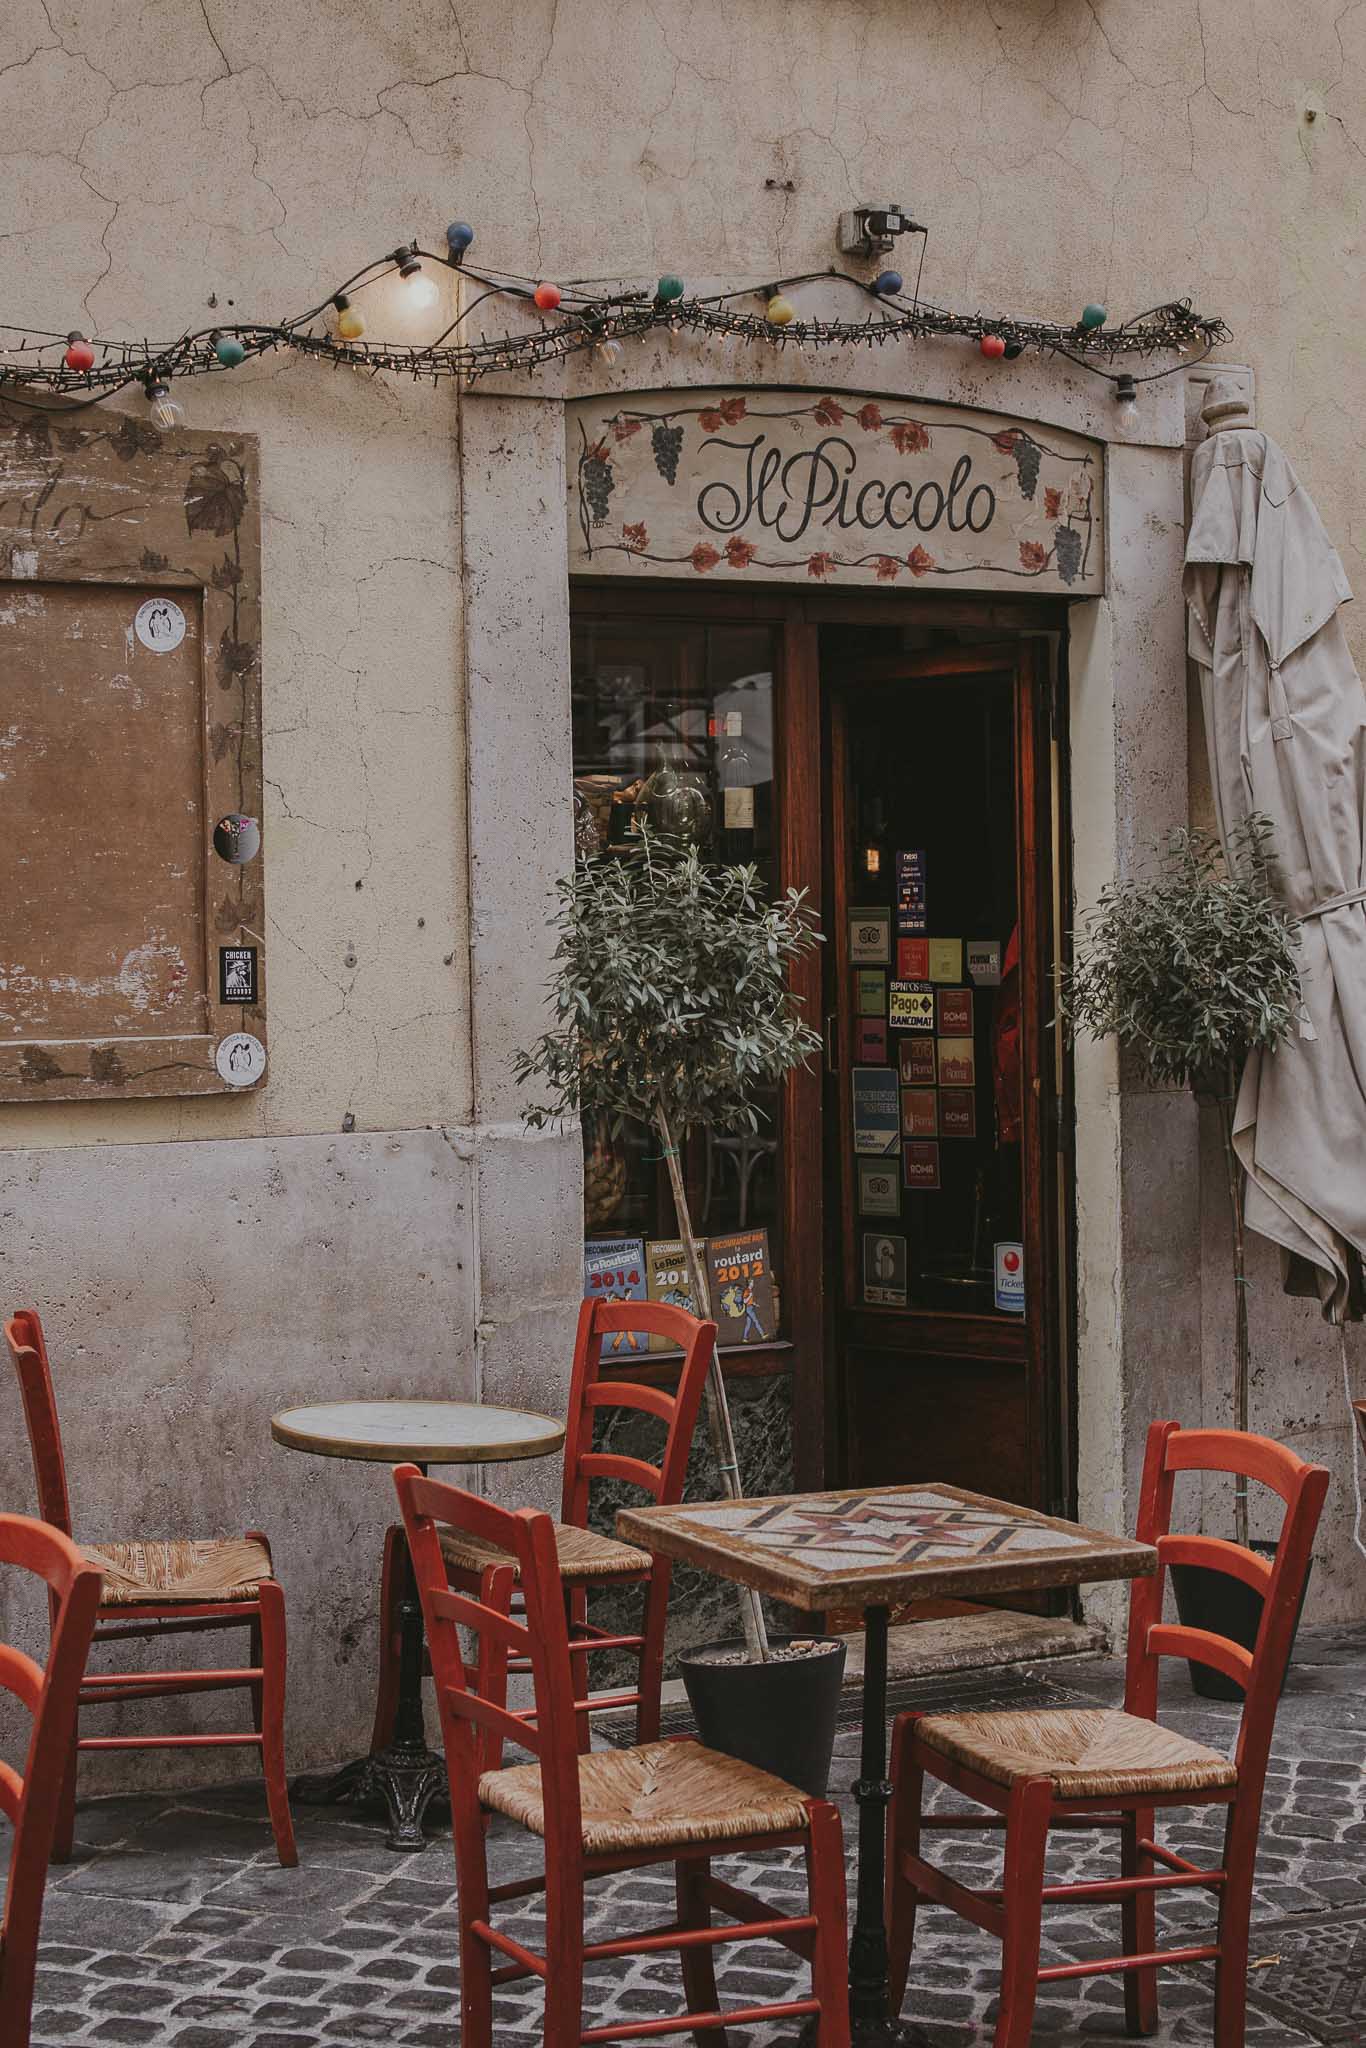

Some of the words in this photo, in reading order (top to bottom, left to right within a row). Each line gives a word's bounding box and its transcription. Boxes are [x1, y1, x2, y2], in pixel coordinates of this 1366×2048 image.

[697, 434, 780, 533] Il
[777, 436, 996, 543] Piccolo
[225, 951, 252, 960] CHICKEN
[891, 994, 919, 1014] Pago
[891, 1016, 933, 1027] BANCOMAT
[714, 1248, 763, 1268] routard
[590, 1269, 640, 1288] 2014
[655, 1270, 688, 1286] 201
[718, 1261, 764, 1283] 2012
